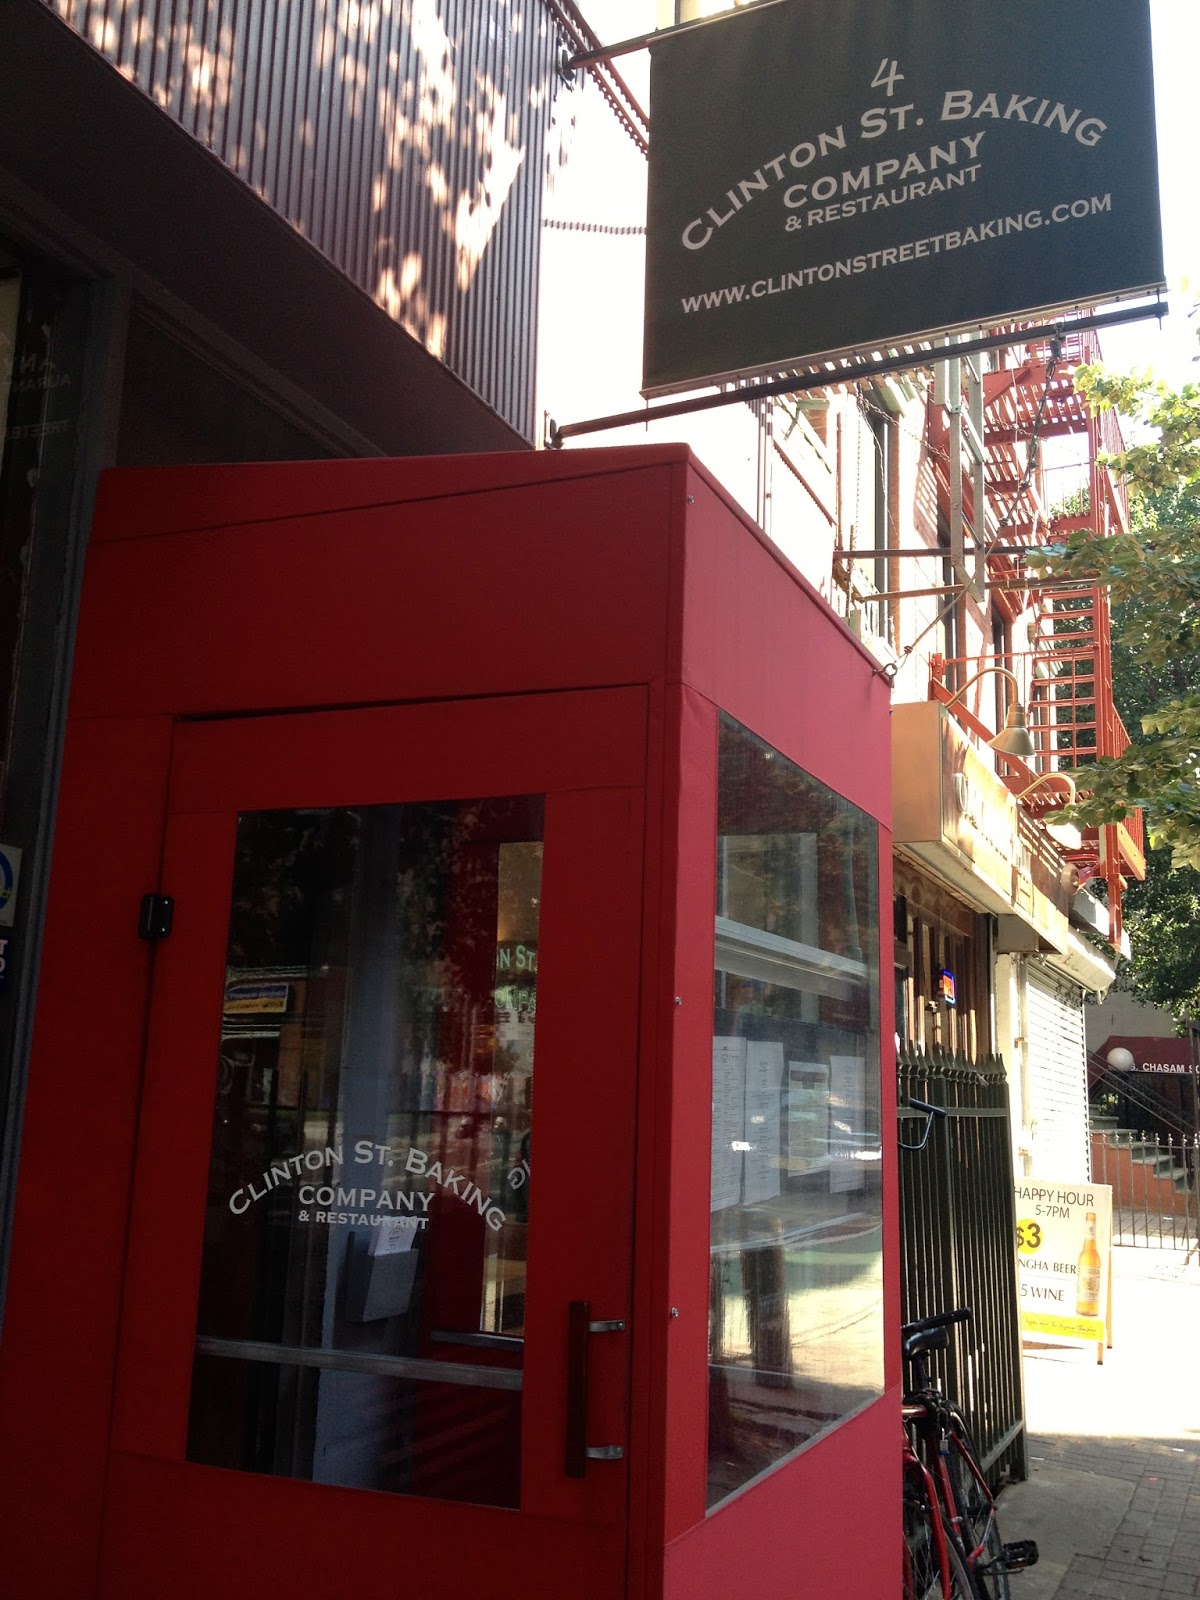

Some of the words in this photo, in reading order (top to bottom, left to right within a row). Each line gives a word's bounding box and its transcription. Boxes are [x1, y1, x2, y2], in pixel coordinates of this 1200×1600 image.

[871, 58, 904, 97] 4
[681, 125, 847, 251] CLINTON
[860, 103, 924, 139] ST.
[939, 89, 1109, 147] BAKING
[782, 131, 986, 209] COMPANY
[785, 215, 803, 232] &
[807, 164, 982, 227] RESTAURANT
[681, 193, 1113, 314] WWW.CLINTONSTREETBAKING.COM
[1142, 1062, 1185, 1073] CHASAM
[228, 1145, 344, 1215] CLINTON
[354, 1140, 394, 1167] ST.
[404, 1147, 507, 1231] BAKING
[1014, 1186, 1054, 1203] HAPPY
[1057, 1190, 1095, 1207] HOUR
[299, 1186, 435, 1212] COMPANY
[1034, 1204, 1070, 1219] 5-7PM
[298, 1210, 310, 1222] &
[316, 1210, 429, 1230] RESTAURANT
[1054, 1261, 1078, 1276] BEER
[1031, 1286, 1065, 1302] WINE
